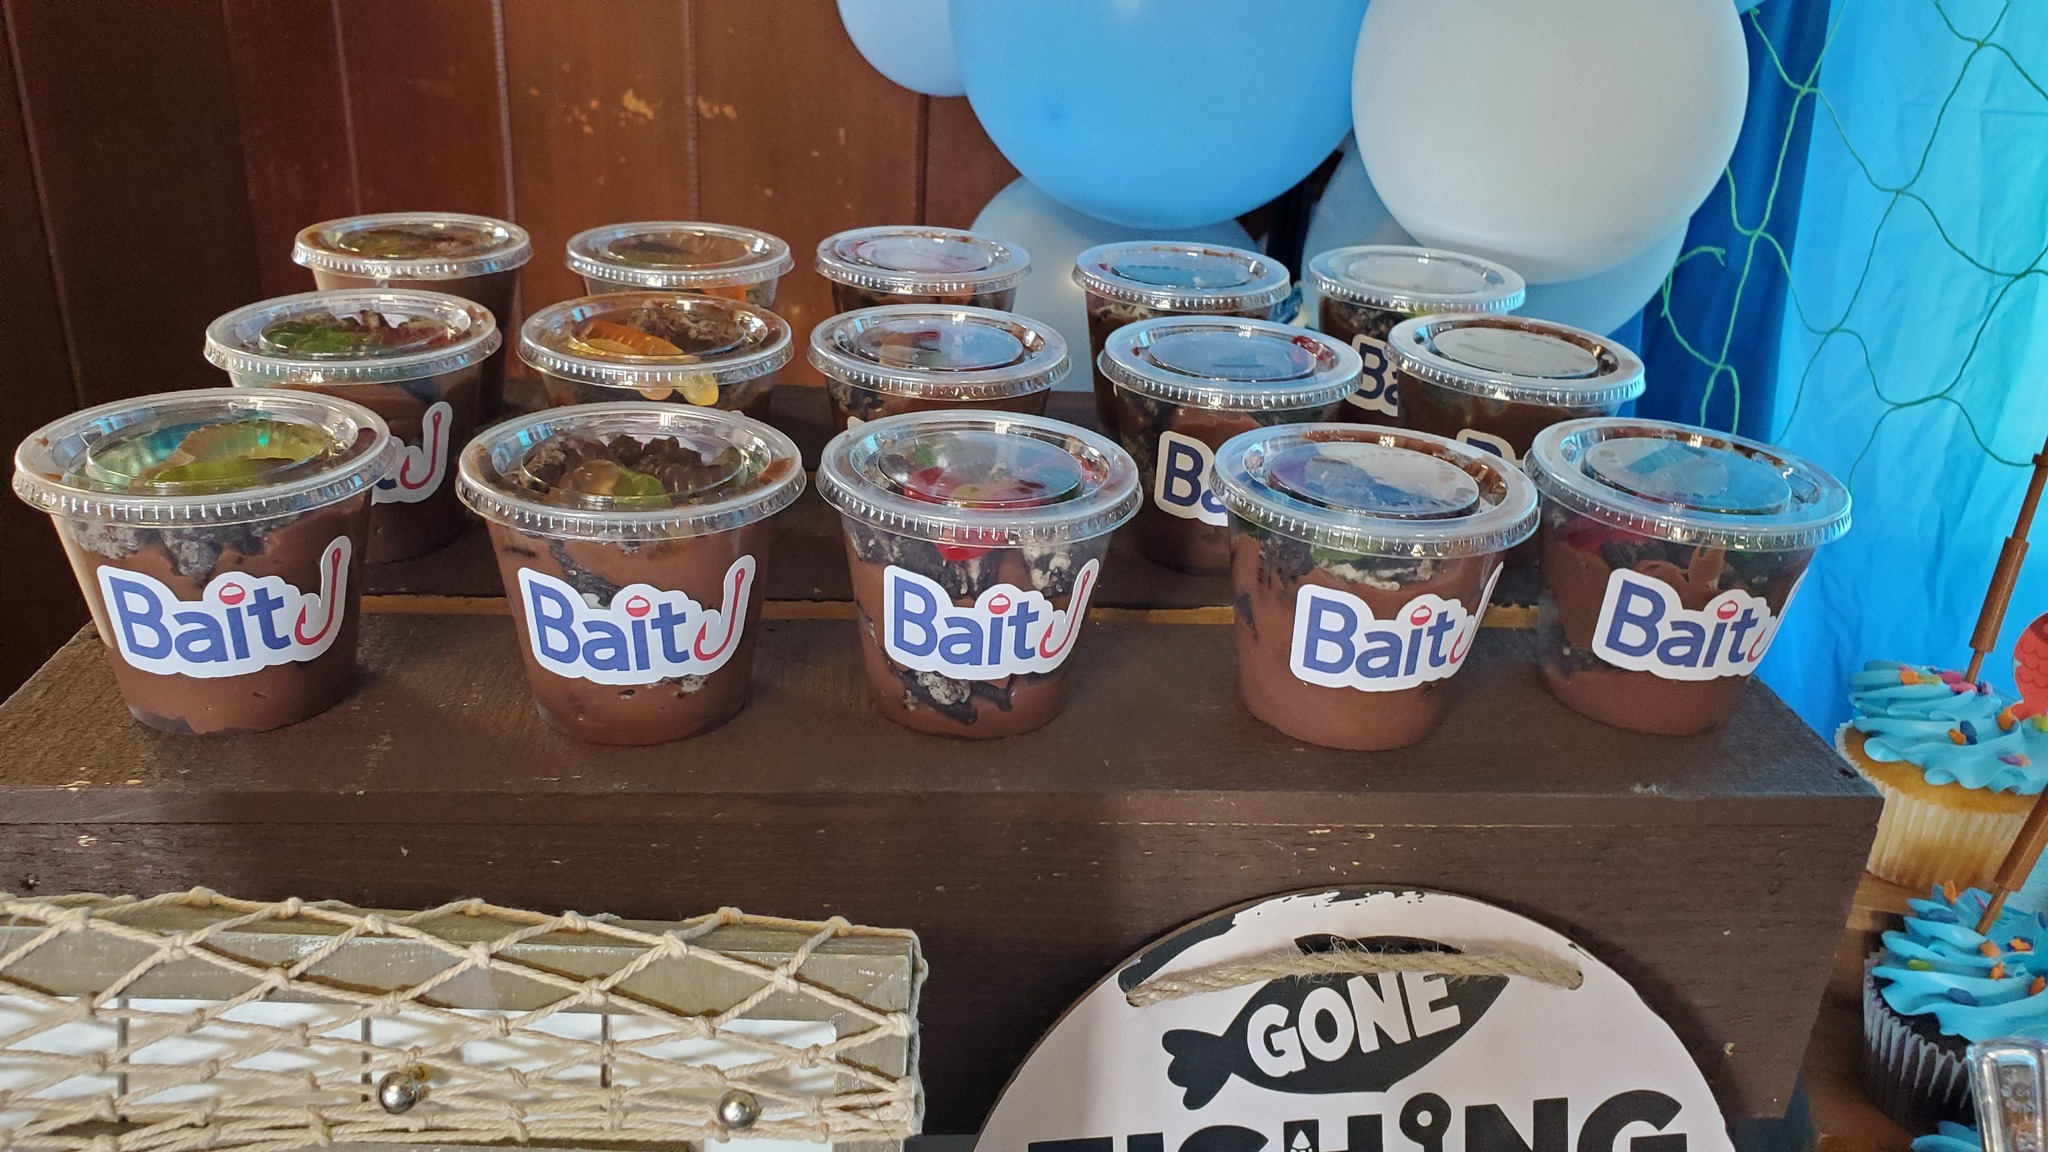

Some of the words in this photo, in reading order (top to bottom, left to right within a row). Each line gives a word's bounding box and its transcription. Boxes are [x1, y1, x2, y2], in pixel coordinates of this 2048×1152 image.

[108, 574, 293, 663] Bait
[528, 579, 688, 673] Bait
[893, 575, 1036, 666] Bait
[1302, 596, 1456, 679] Bait
[1604, 580, 1758, 669] Bait
[1247, 971, 1461, 1078] GONE
